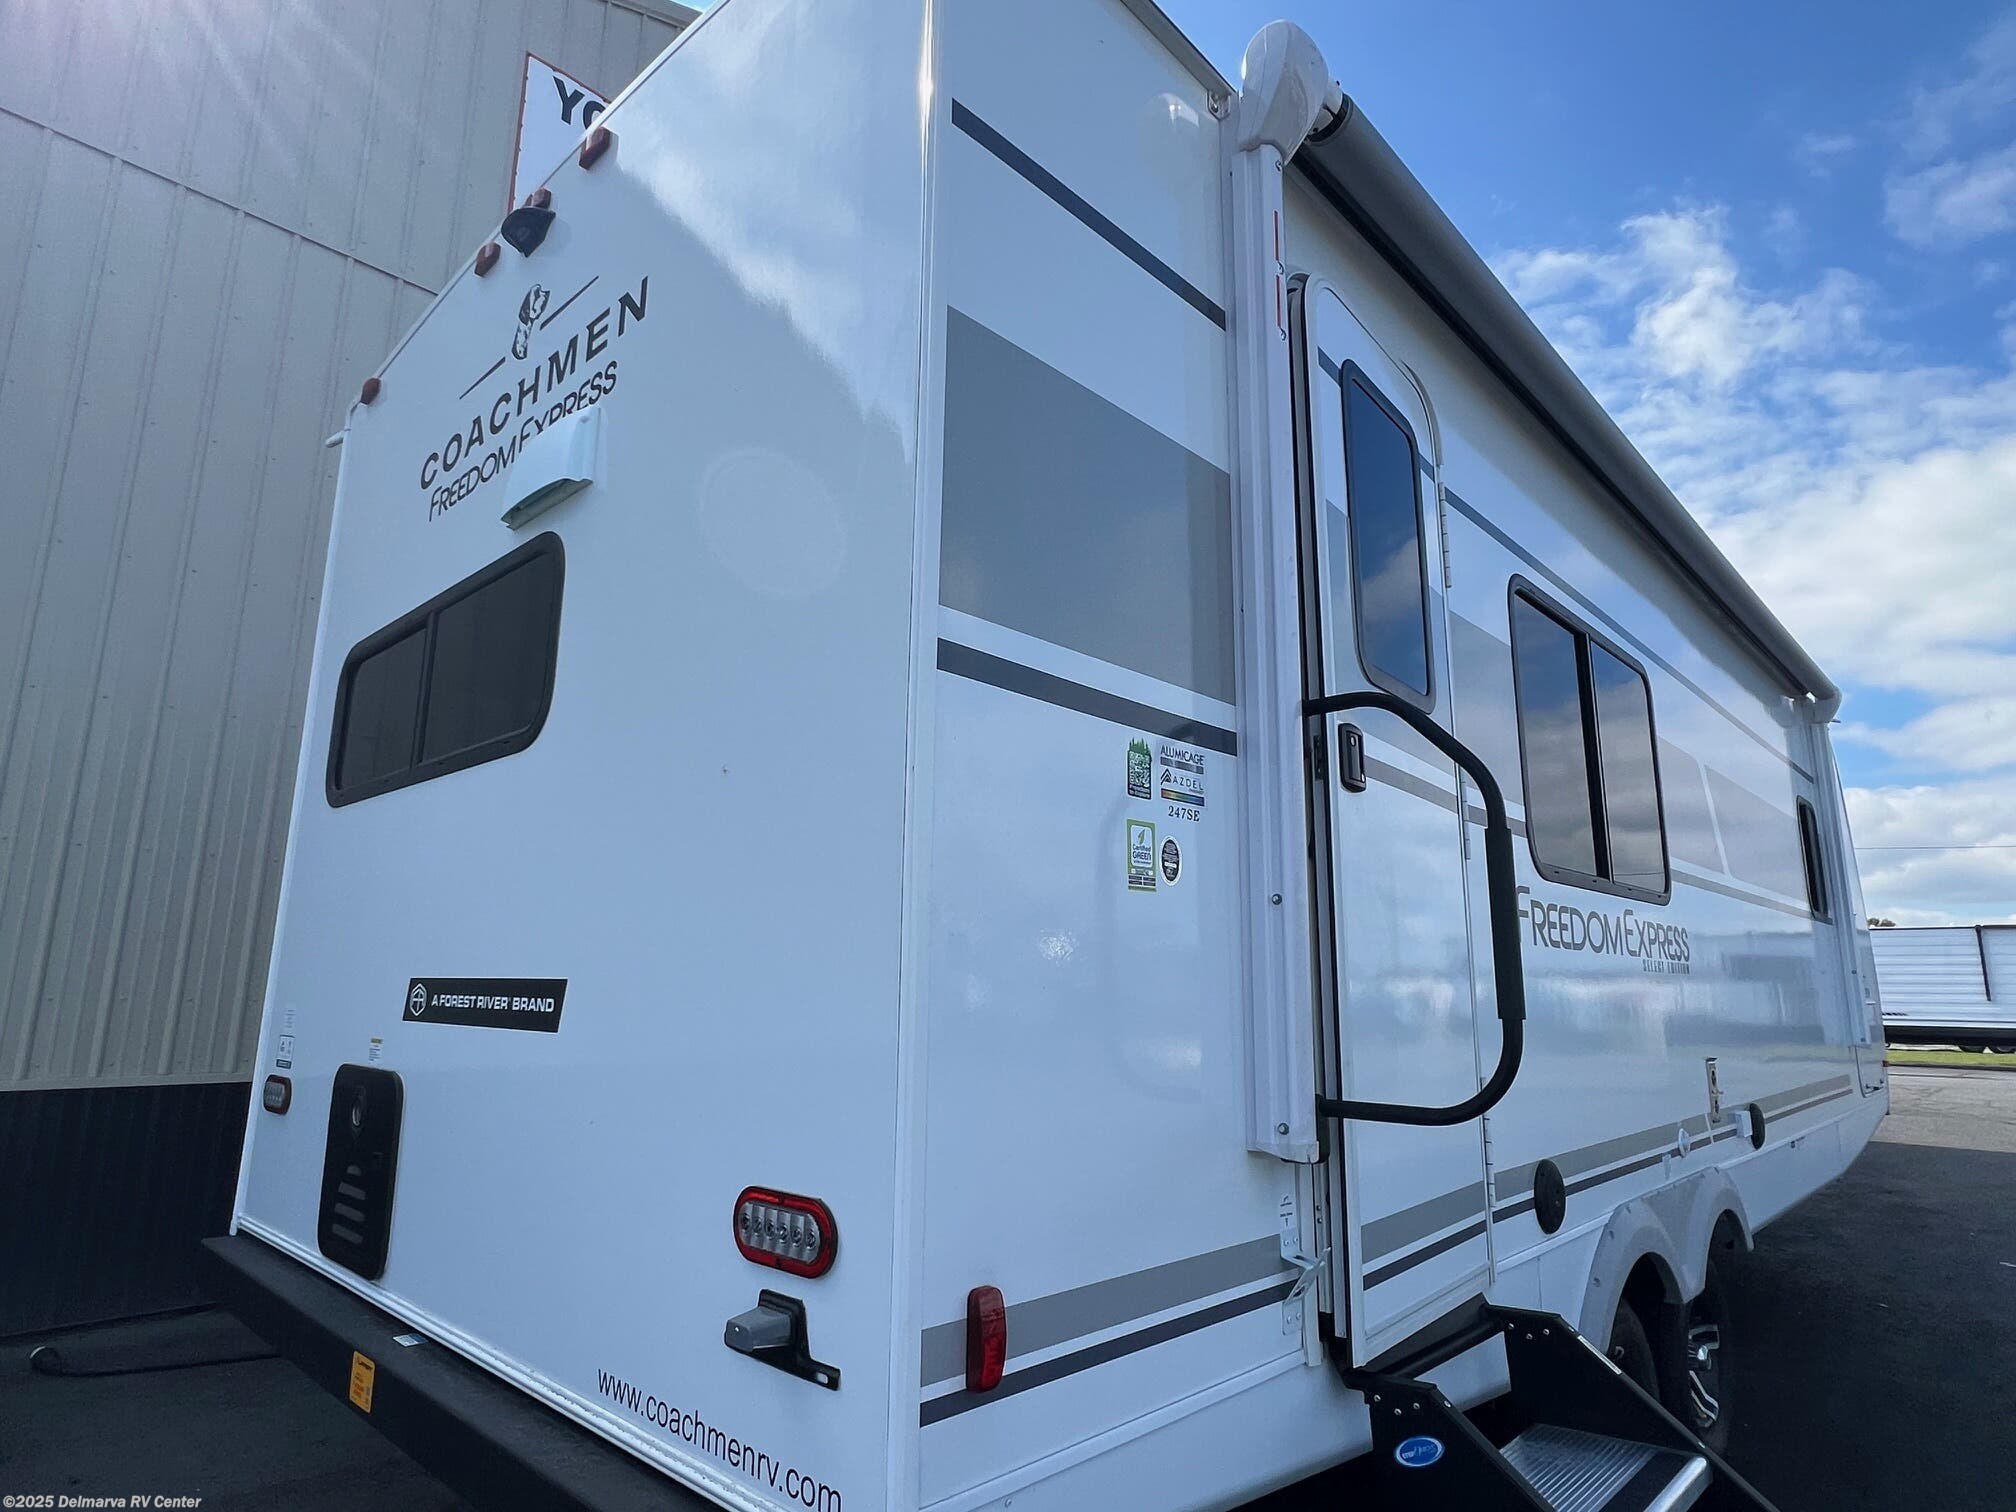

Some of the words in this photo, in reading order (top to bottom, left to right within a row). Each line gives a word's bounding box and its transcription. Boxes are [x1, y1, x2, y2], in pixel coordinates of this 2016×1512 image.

[420, 276, 649, 490] COACHMEN
[1160, 745, 1205, 766] ALUMICAGE
[1173, 775, 1204, 791] AZDEL
[1168, 805, 1201, 822] 247SE
[431, 995, 439, 1007] A
[439, 995, 476, 1009] FOREST
[512, 997, 555, 1012] BRAND
[598, 1368, 842, 1511] www.coachmenrv.com
